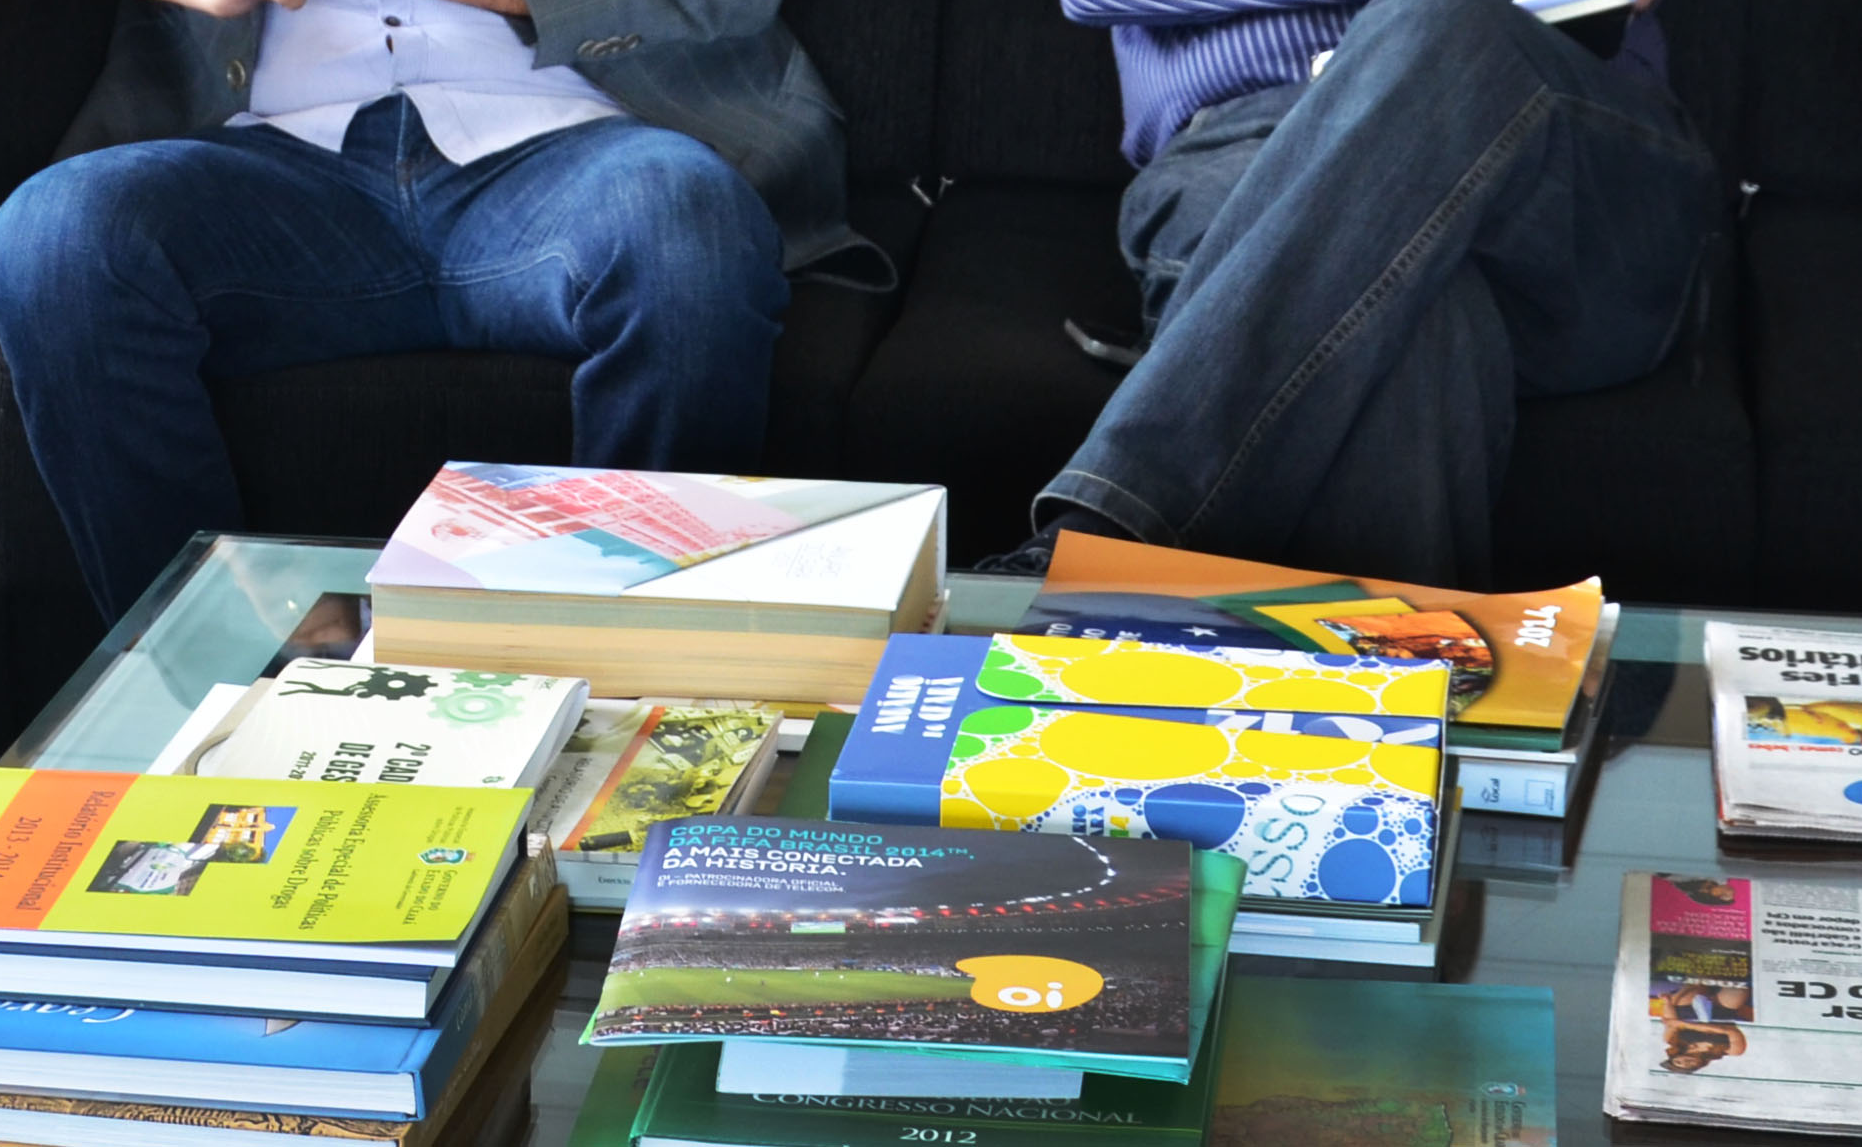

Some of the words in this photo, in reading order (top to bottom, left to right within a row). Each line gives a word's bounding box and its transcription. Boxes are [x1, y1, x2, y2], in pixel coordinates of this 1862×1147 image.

[1513, 604, 1562, 648] 2014
[1738, 645, 1862, 670] tários
[1780, 670, 1862, 687] Fies
[334, 742, 376, 759] DE
[320, 759, 367, 783] GES
[377, 757, 424, 784] CAD
[64, 790, 116, 839] Relatório
[348, 792, 388, 836] Assessoria
[6, 815, 43, 843] 2013
[305, 809, 345, 847] Públicas
[670, 825, 739, 838] COPA
[746, 826, 782, 839] DO
[789, 828, 883, 845] MUNDO
[1246, 793, 1327, 884] SSO
[327, 838, 366, 877] Especial
[664, 847, 683, 859] A
[689, 846, 760, 859] MAIS
[766, 849, 923, 868] CONECTADA
[668, 836, 703, 848] DA
[711, 836, 772, 849] FIFA
[780, 839, 878, 856] BRASIL
[290, 848, 319, 875] sobre
[662, 857, 698, 870] DA
[705, 856, 847, 876] HISTÓRIA.
[15, 840, 83, 912] Institucional
[321, 878, 346, 891] de
[668, 879, 762, 889] FORNECEDORA
[764, 883, 782, 891] DE
[684, 872, 788, 885] PATROCINADORA
[270, 877, 309, 909] Drogas
[298, 892, 339, 930] Políticas
[1776, 979, 1838, 1000] CE
[966, 1102, 1143, 1125] NACIONAL
[899, 1126, 977, 1144] 2012
